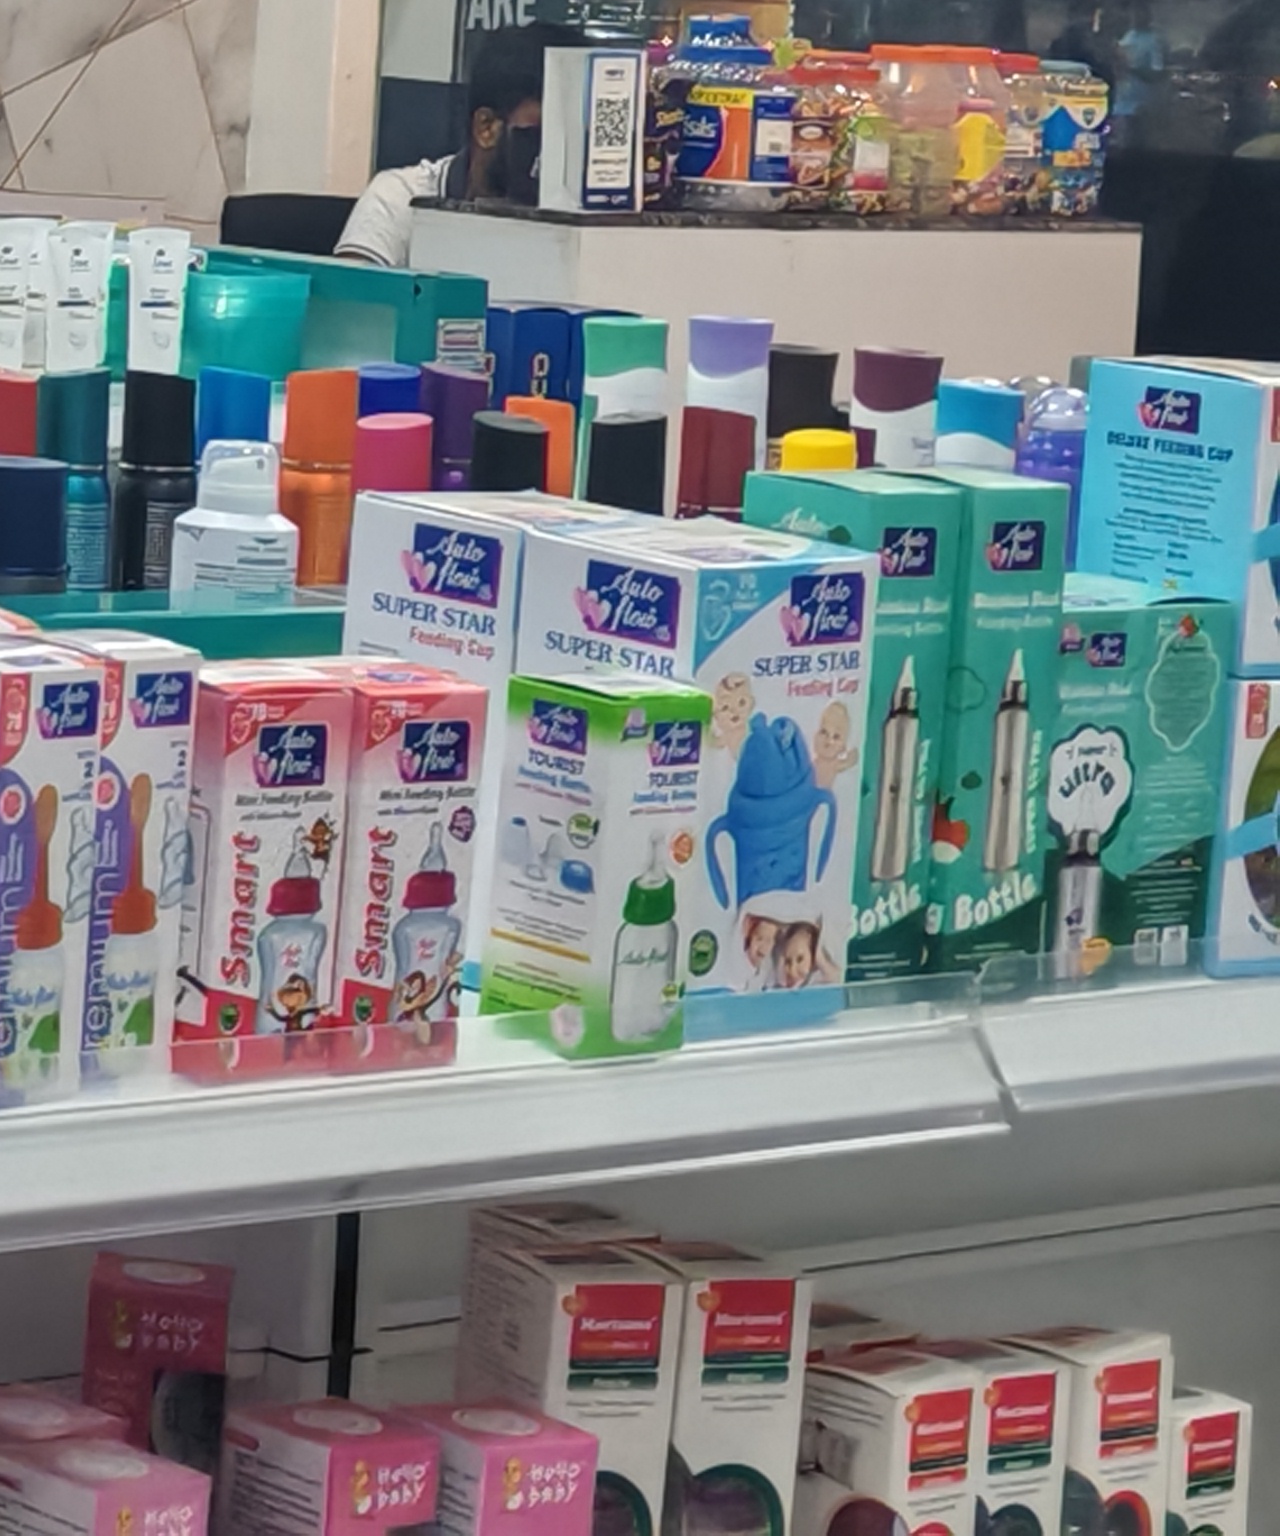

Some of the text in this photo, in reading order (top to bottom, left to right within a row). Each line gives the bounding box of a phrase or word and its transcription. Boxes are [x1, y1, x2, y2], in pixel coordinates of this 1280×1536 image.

[371, 591, 497, 637] SUPER STAR
[544, 629, 675, 677] SUPER STAR
[752, 650, 861, 678] SUPER STAR
[1057, 761, 1116, 799] ultra
[219, 827, 261, 988] Smart
[354, 824, 396, 980] Smart
[954, 872, 1037, 931] Bottle
